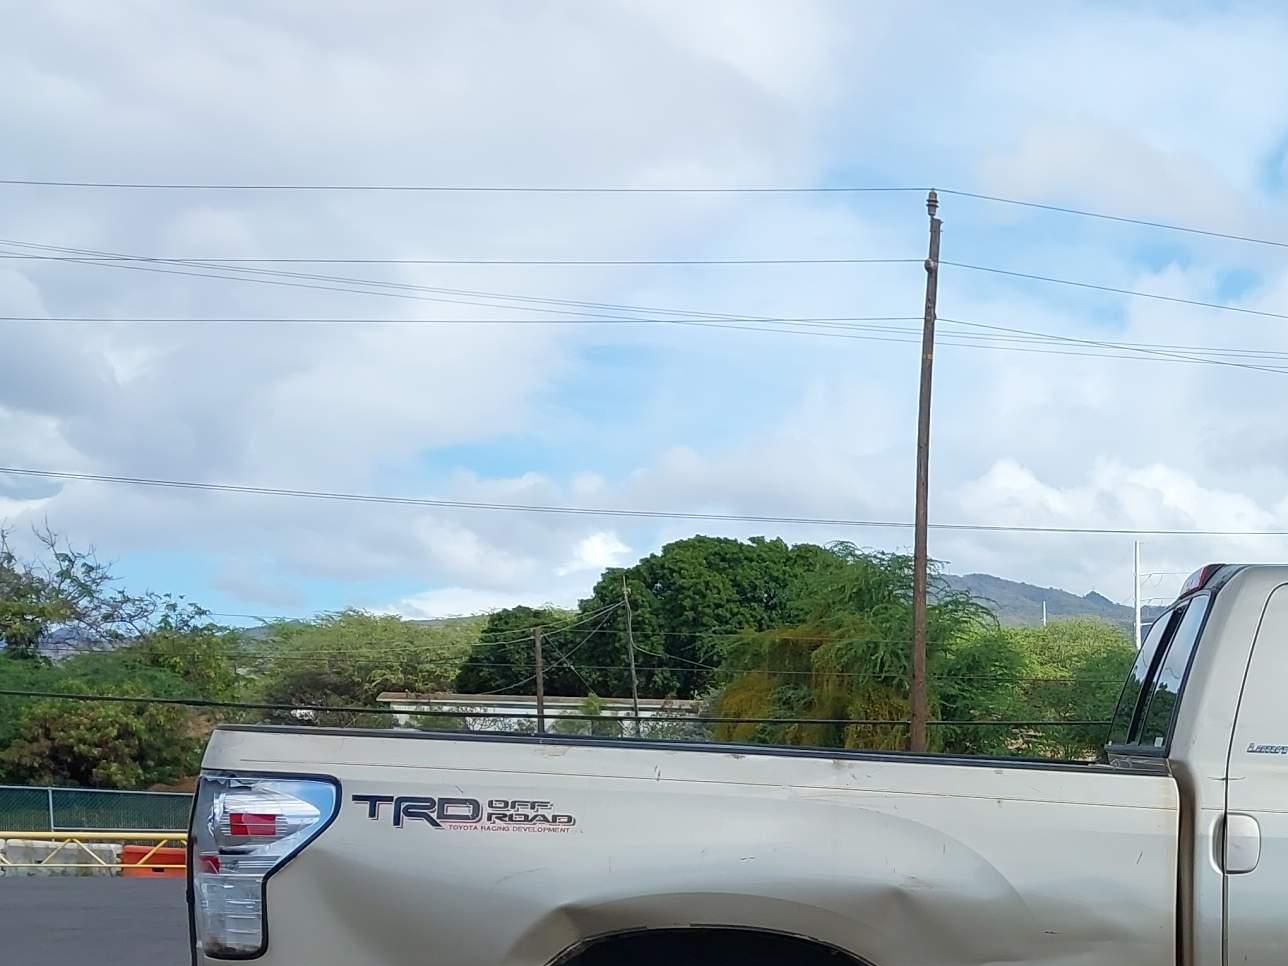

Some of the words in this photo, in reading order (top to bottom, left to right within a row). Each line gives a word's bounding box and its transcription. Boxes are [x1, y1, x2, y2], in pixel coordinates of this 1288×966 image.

[351, 794, 483, 829] TRD
[487, 800, 554, 812] OFF
[486, 812, 576, 826] ROAD
